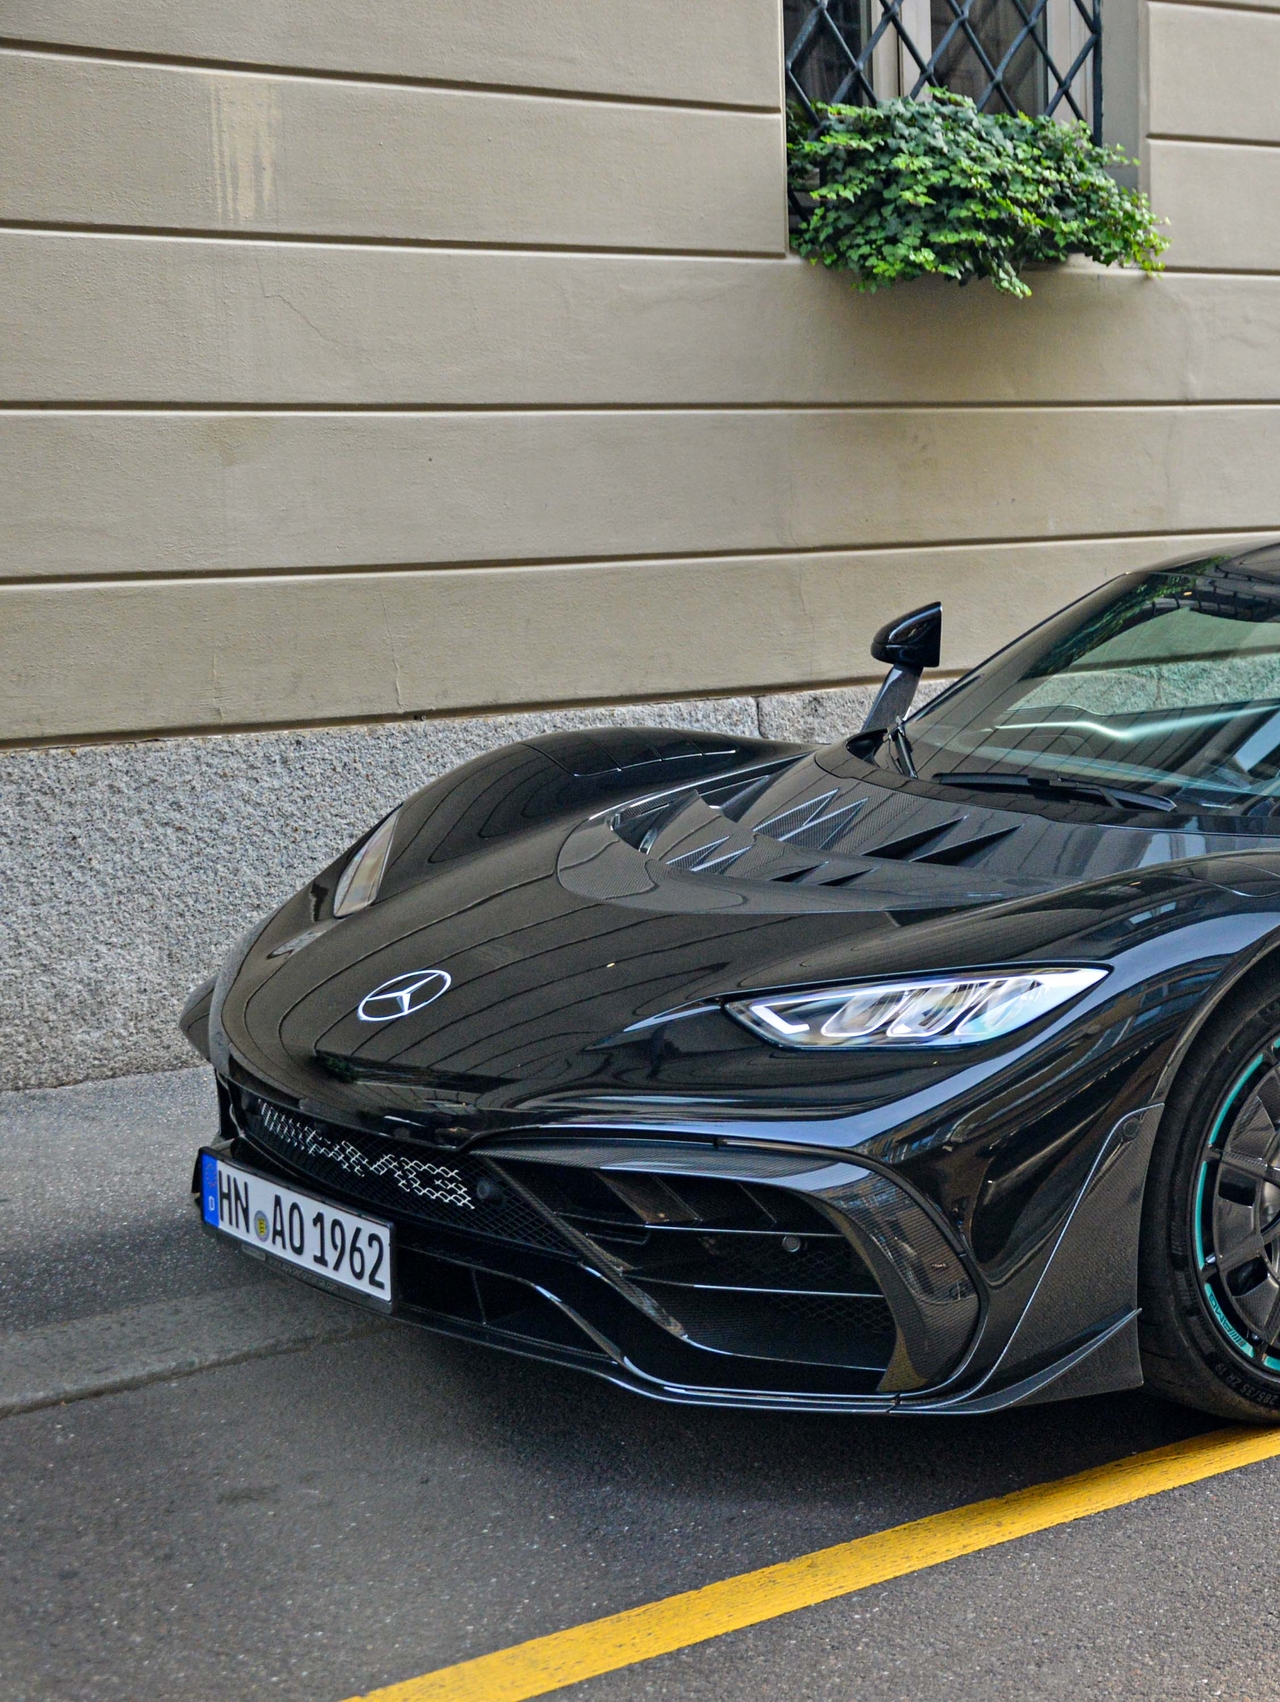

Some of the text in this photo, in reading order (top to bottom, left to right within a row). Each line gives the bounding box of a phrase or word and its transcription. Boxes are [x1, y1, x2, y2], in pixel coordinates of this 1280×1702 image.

[218, 1170, 250, 1233] HN
[272, 1194, 305, 1256] AO
[312, 1211, 385, 1290] 1962
[1228, 1373, 1242, 1388] ZR
[1240, 1383, 1279, 1406] 285/35
